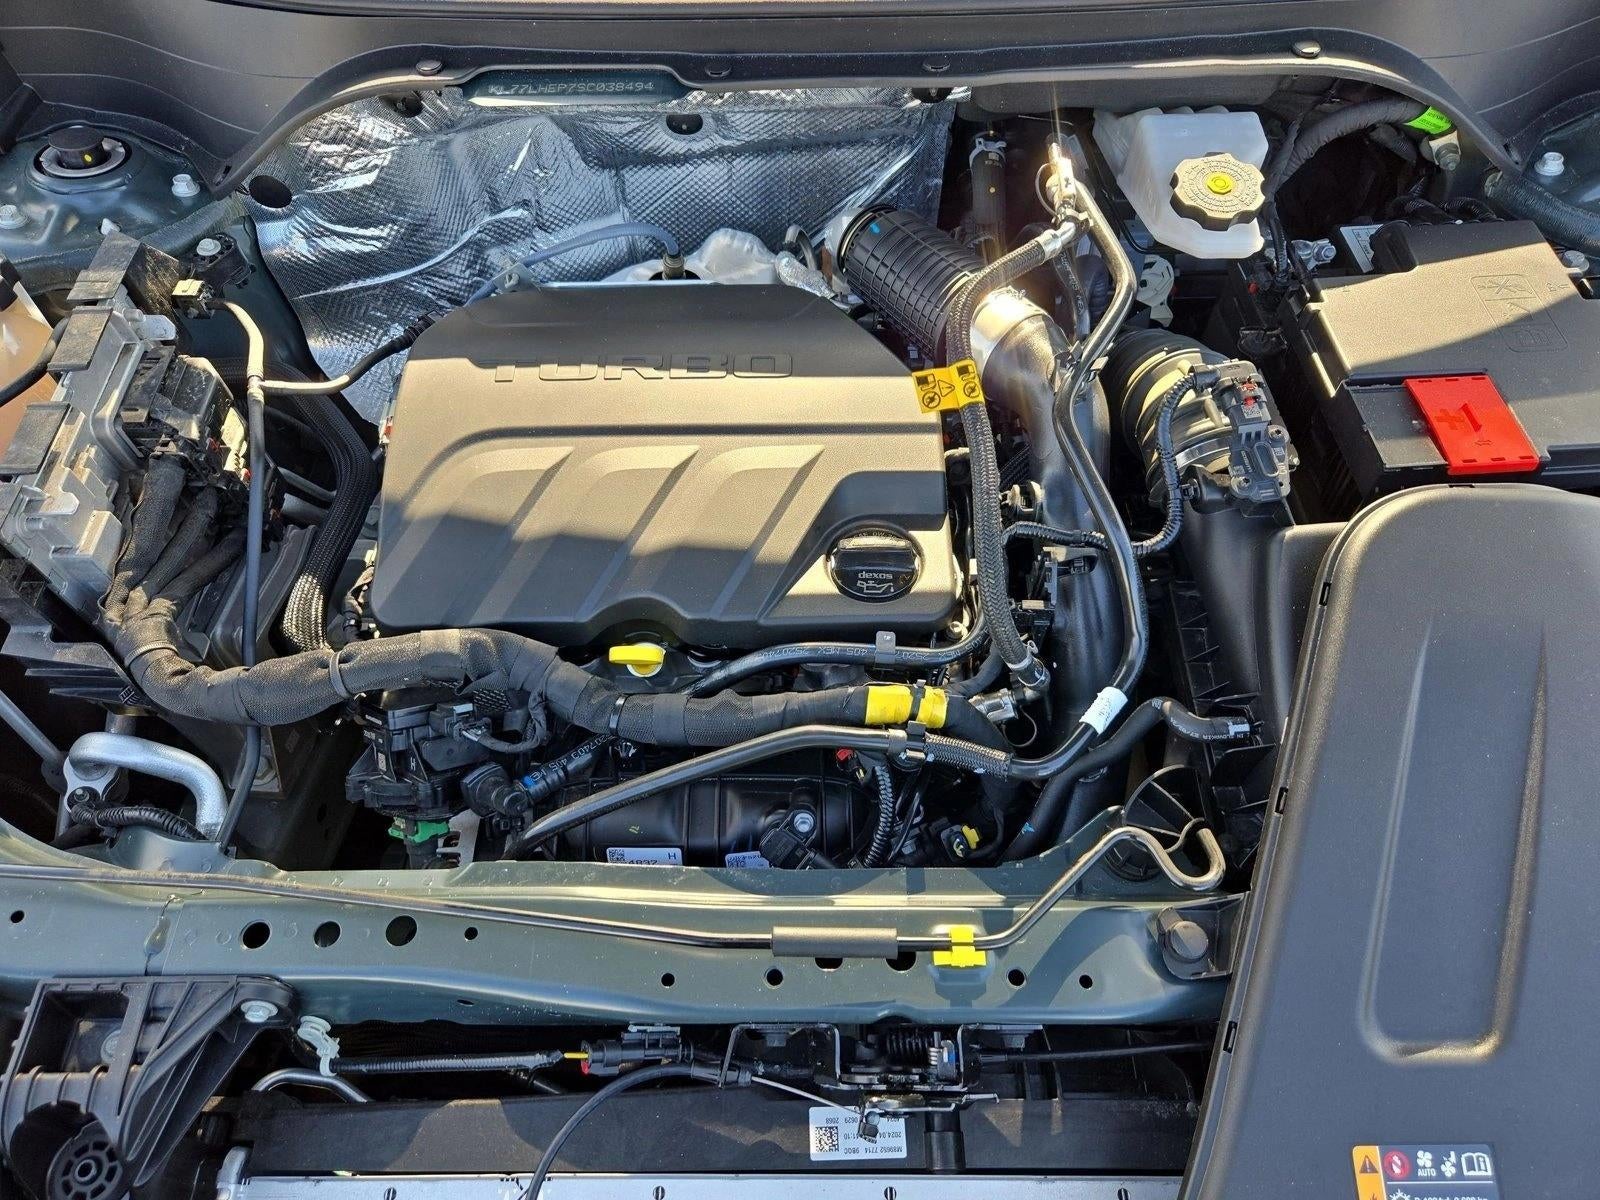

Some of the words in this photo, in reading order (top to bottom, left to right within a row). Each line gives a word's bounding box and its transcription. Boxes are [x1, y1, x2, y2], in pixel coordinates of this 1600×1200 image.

[477, 353, 793, 383] TURBO
[858, 571, 893, 579] dexos
[817, 646, 840, 655] MEX
[846, 647, 868, 656] 405
[938, 650, 961, 660] MEX
[668, 852, 677, 860] H
[1417, 1169, 1436, 1177] AUTO
